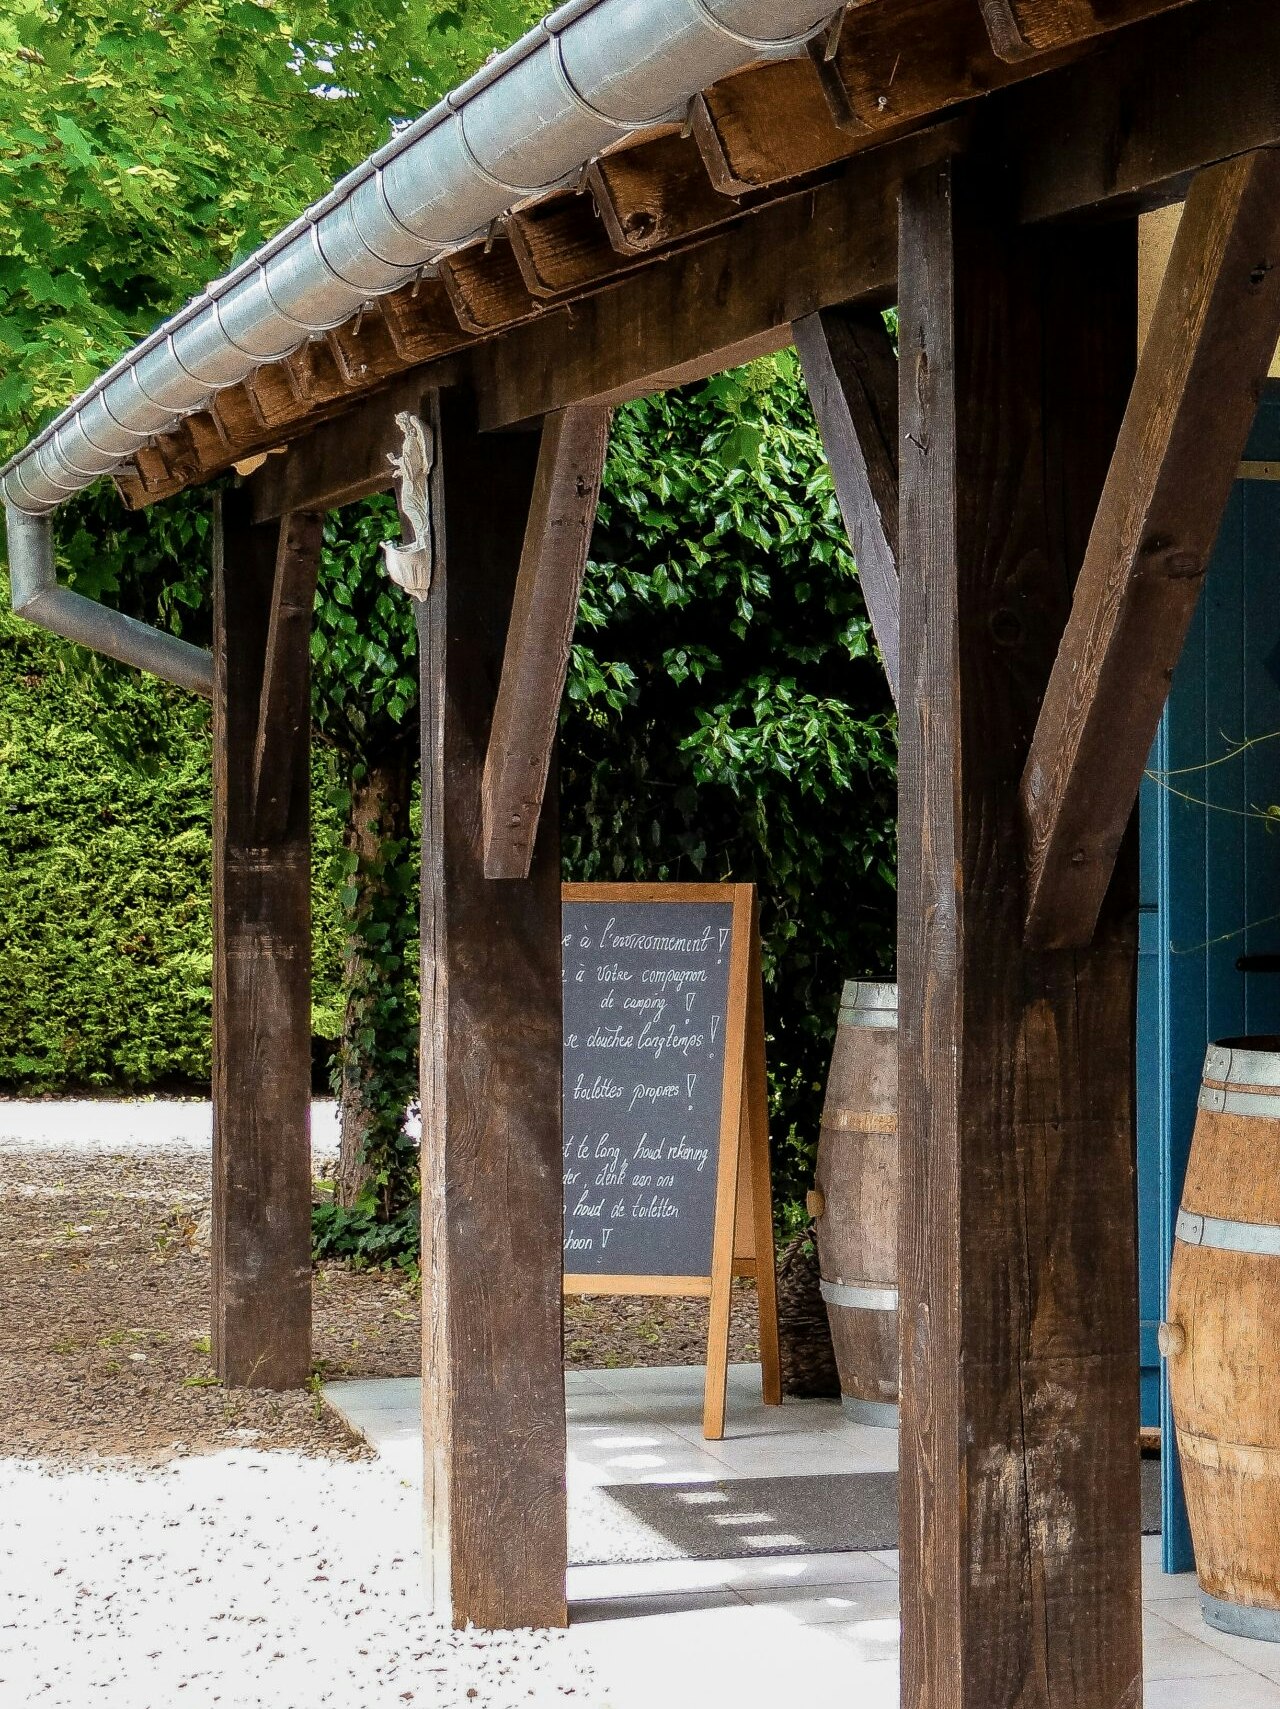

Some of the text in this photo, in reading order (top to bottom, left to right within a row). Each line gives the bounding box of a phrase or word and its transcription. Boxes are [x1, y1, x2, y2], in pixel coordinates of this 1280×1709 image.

[580, 924, 592, 948] à
[575, 963, 586, 982] à
[641, 969, 708, 992] compagnon
[600, 989, 614, 1009] de
[623, 993, 668, 1022] camping
[637, 1021, 704, 1059] longtemps
[574, 1073, 624, 1100] toilettes
[628, 1084, 680, 1112] propres
[577, 1134, 590, 1158] te
[633, 1132, 666, 1160] houd
[667, 1135, 709, 1172] rekening
[594, 1158, 629, 1186] denk
[631, 1174, 652, 1187] aan
[656, 1174, 675, 1187] ons
[572, 1190, 606, 1217] houd
[610, 1198, 626, 1218] de
[632, 1194, 679, 1218] toiletten
